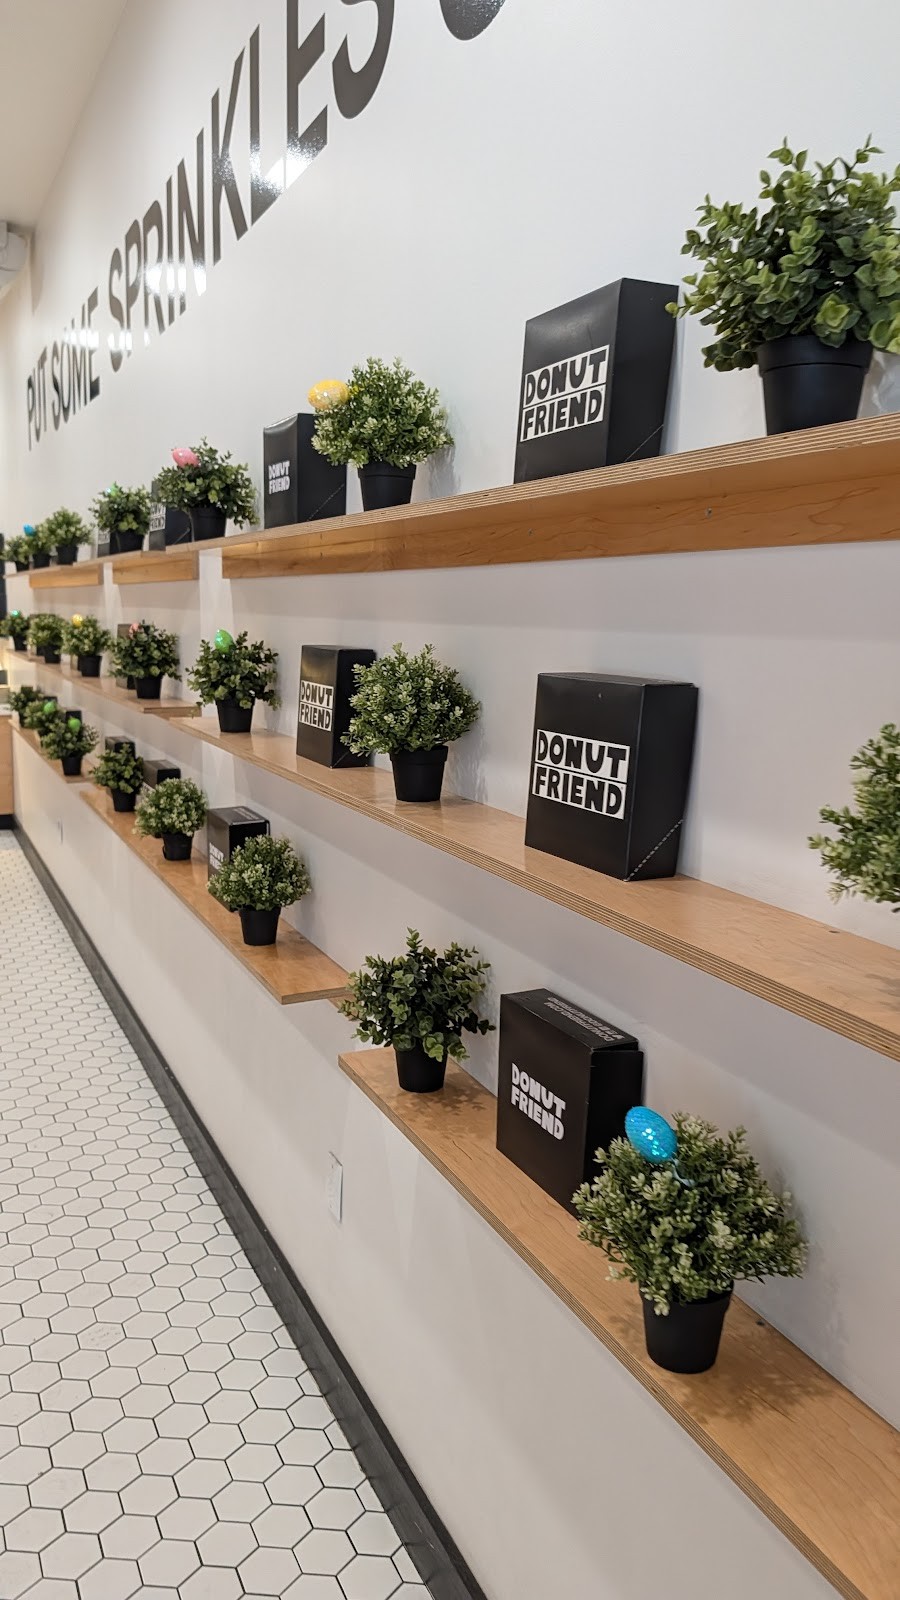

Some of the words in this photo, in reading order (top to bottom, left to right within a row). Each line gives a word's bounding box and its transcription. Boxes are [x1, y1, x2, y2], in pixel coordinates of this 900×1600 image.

[27, 345, 47, 452] PUT
[52, 285, 100, 432] SOME
[524, 347, 607, 407] DONUT
[522, 386, 604, 440] FRIEND
[268, 460, 290, 480] DONUT
[269, 475, 290, 495] FRIEND
[300, 703, 332, 730] FRIEND
[301, 681, 333, 708] DONUT
[537, 730, 628, 780] DONUT
[534, 765, 624, 817] FRIEND
[511, 1063, 567, 1119] DONUT
[511, 1085, 565, 1140] FRIEND
